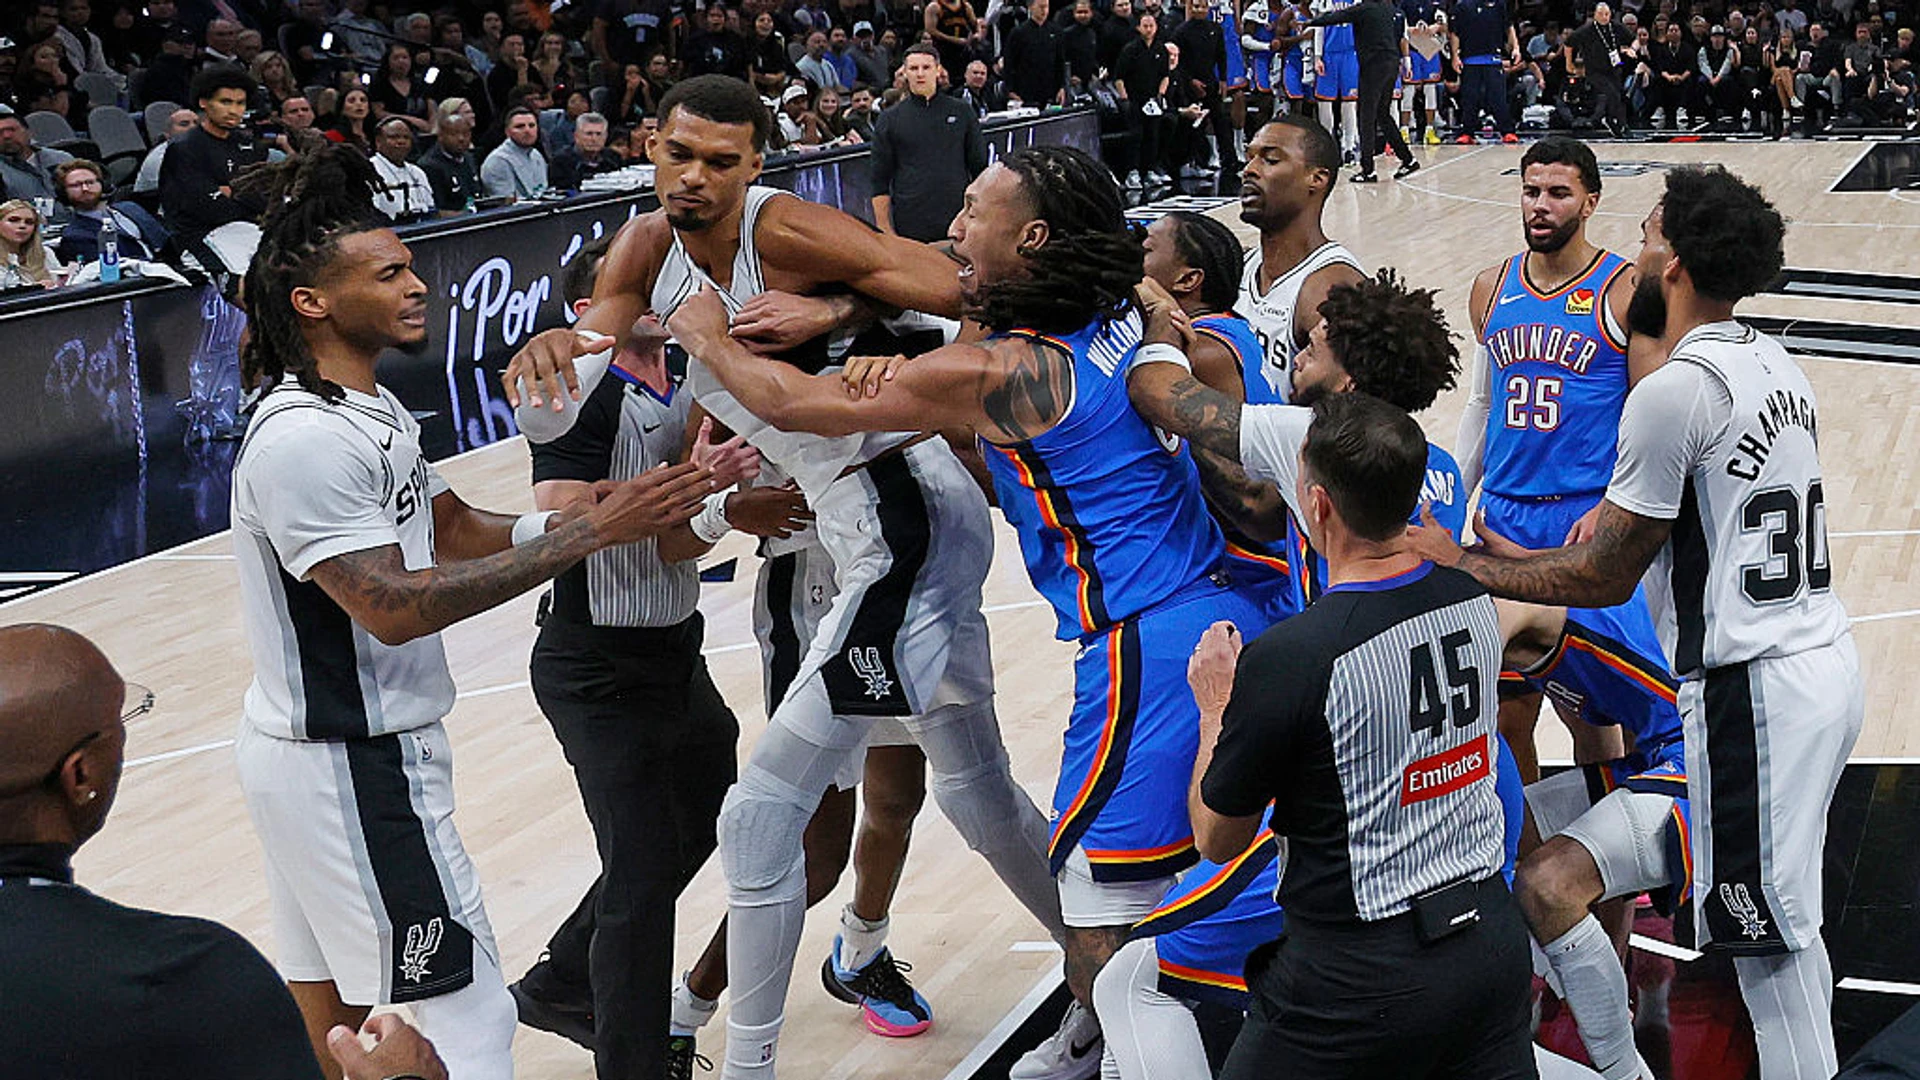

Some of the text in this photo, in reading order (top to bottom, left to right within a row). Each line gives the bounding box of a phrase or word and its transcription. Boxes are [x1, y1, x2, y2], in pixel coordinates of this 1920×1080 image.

[1487, 324, 1598, 375] THUNDER
[1505, 374, 1563, 432] 25
[1417, 468, 1455, 506] AMS
[1740, 478, 1831, 608] 30
[1410, 627, 1480, 738] 45
[1408, 750, 1483, 793] Emirates
